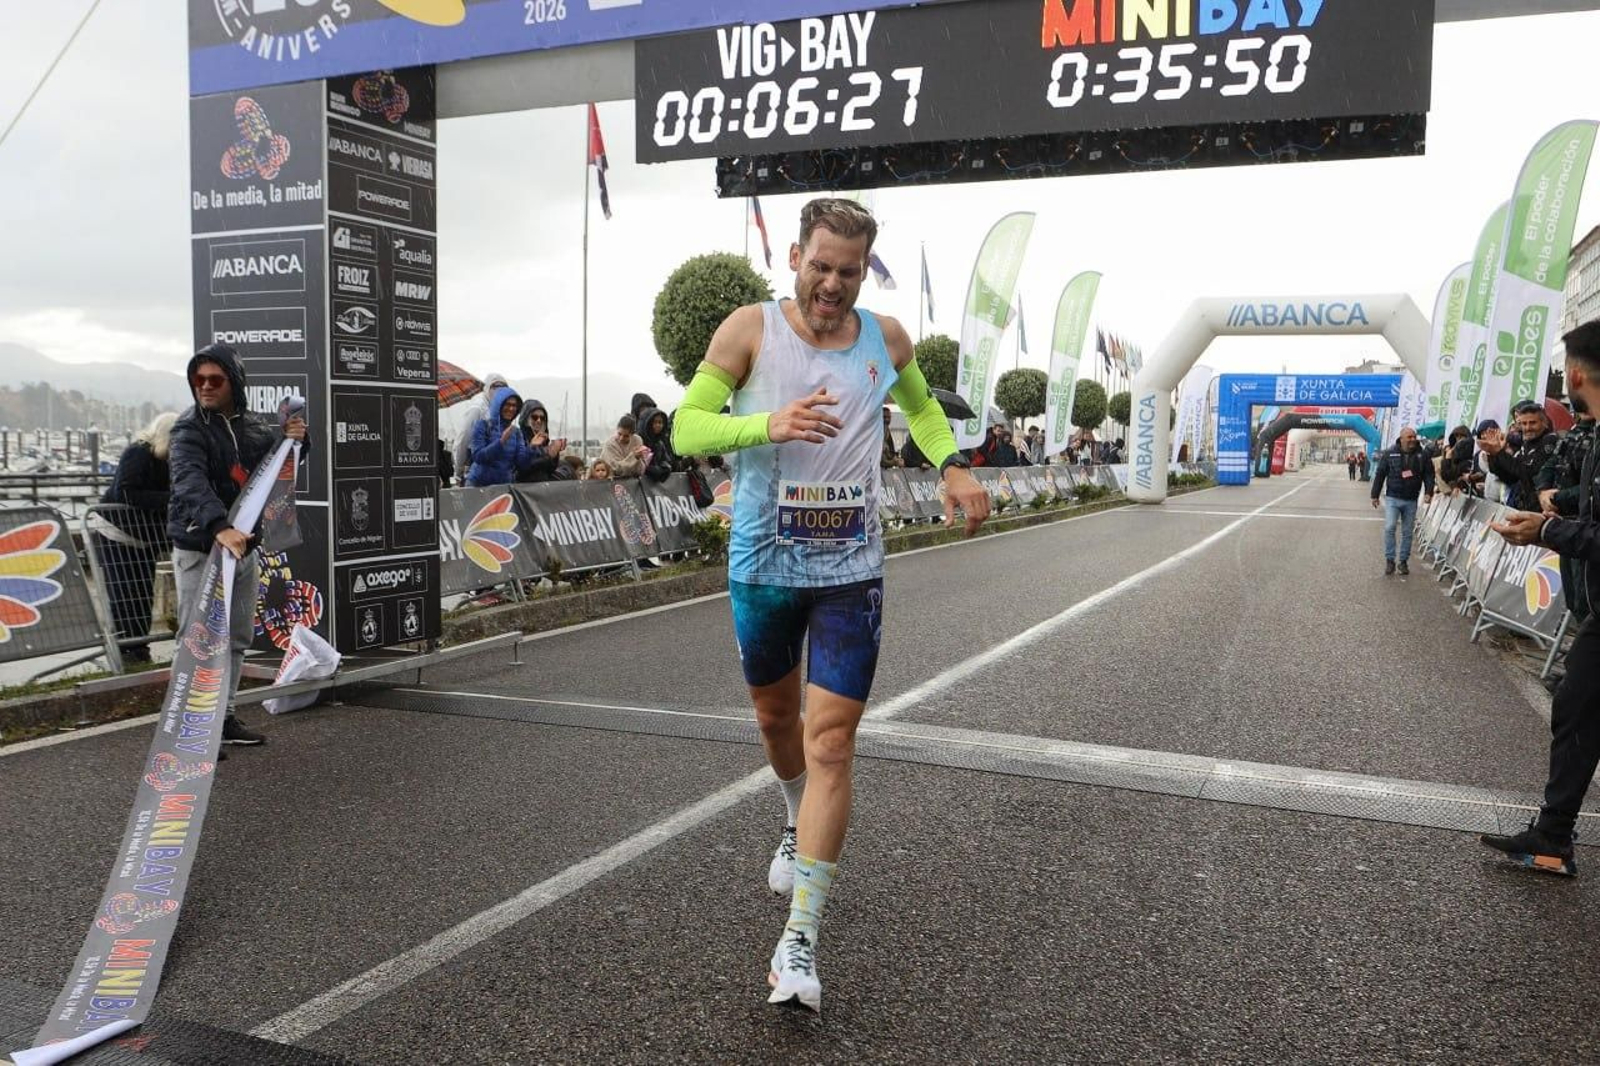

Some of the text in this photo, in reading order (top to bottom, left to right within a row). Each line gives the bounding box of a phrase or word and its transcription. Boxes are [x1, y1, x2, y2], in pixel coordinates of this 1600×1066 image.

[524, 0, 567, 25] 2026
[717, 11, 876, 79] VIG BAY
[1046, 34, 1312, 108] 0:35:50
[653, 66, 923, 147] 00:06:27
[193, 180, 322, 210] De la media, la mitad
[1524, 174, 1550, 241] El poder
[1535, 139, 1580, 284] de la colaboración
[399, 249, 432, 265] aqualia
[338, 265, 370, 287] FROIZ
[395, 281, 431, 300] MRW
[214, 329, 305, 344] POWERADE
[1517, 309, 1543, 403] embes
[1300, 379, 1345, 389] XUNTA
[1300, 390, 1373, 400] DE GALICIA
[348, 424, 369, 432] XUNTA
[348, 432, 381, 441] DE GALICIA
[785, 486, 860, 502] MINIBAY
[541, 507, 617, 546] MINIBAY
[794, 509, 854, 528] 10067
[440, 519, 464, 562] AY
[174, 665, 225, 754] MINIBAY
[134, 794, 197, 896] MINIBAY
[75, 939, 156, 1031] MINIBA
